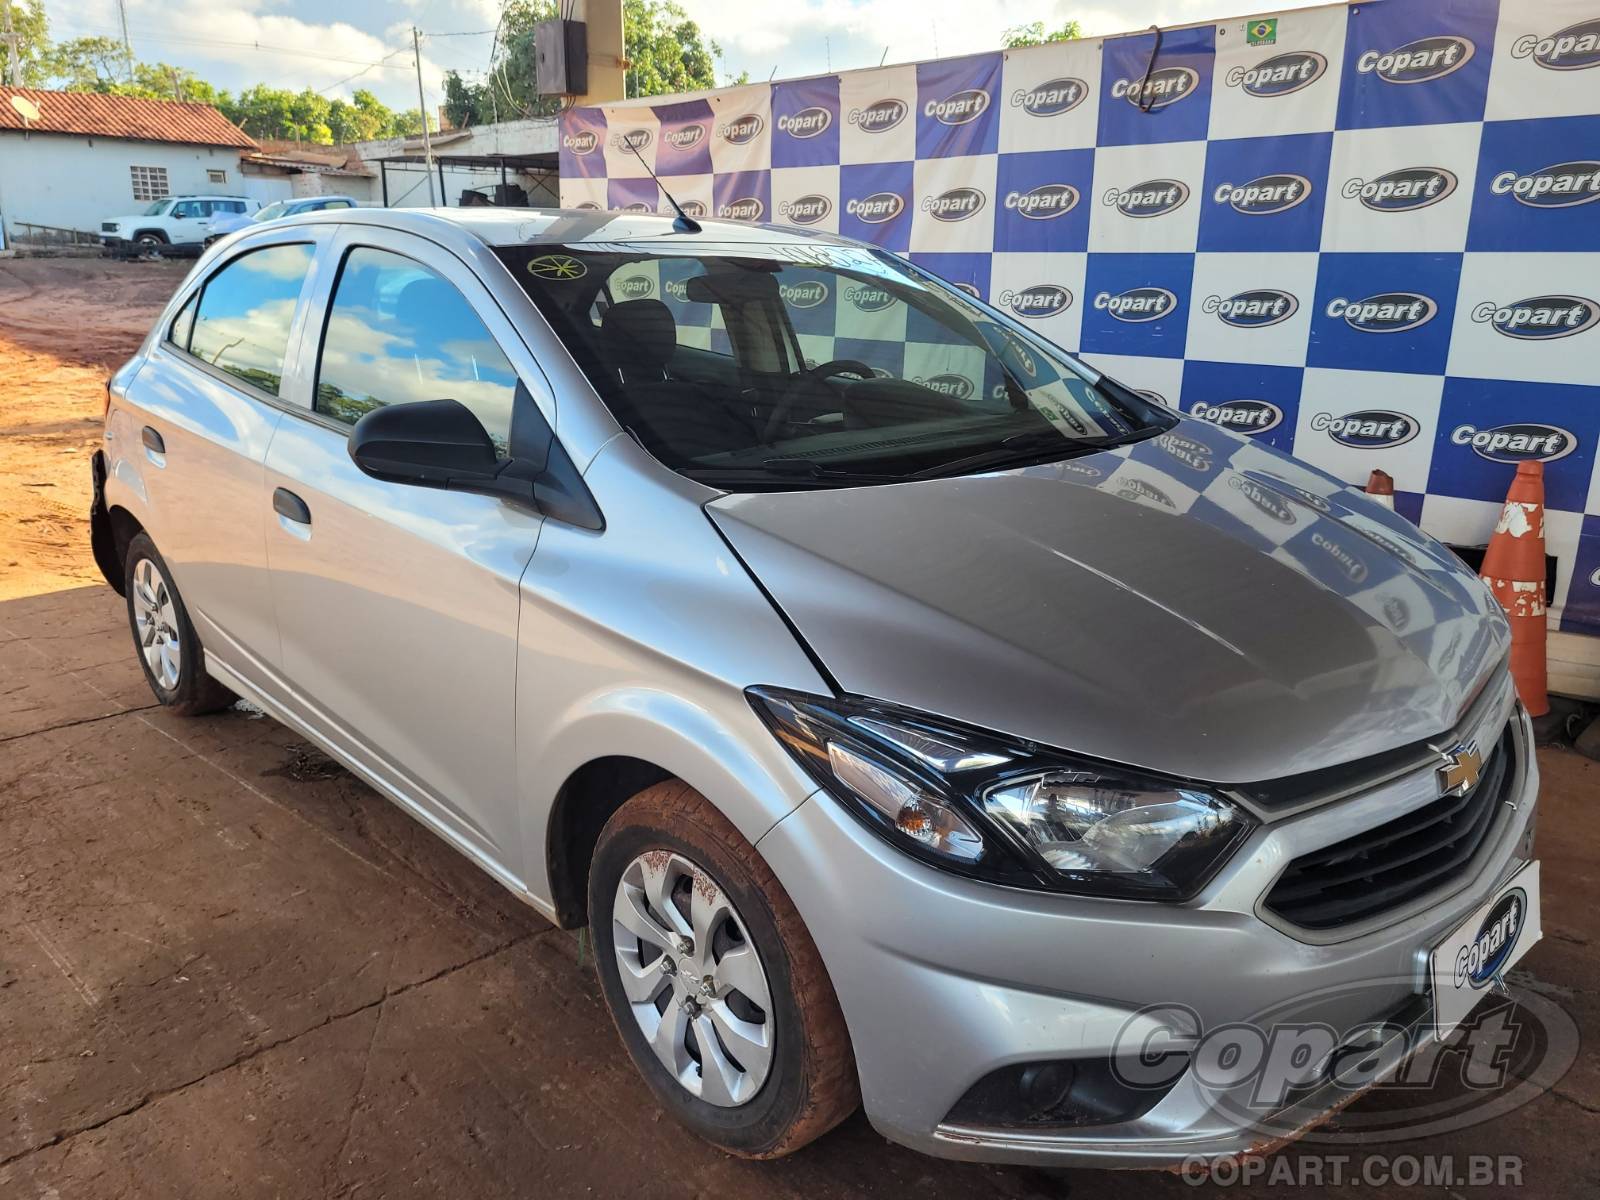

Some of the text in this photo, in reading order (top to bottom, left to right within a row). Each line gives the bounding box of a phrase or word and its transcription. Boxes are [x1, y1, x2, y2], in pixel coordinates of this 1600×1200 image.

[1357, 43, 1459, 75] Copart
[1511, 33, 1600, 62] Copa
[1225, 59, 1314, 88] Copart
[925, 95, 983, 118] Copart
[1011, 85, 1078, 107] Copart
[777, 114, 825, 131] Copart
[848, 105, 900, 126] Copart
[664, 128, 702, 146] Copart
[716, 120, 758, 141] Copart
[563, 135, 594, 150] Copart
[1214, 178, 1298, 206] Copart
[1342, 175, 1441, 202] Copart
[1491, 171, 1600, 199] Copart
[778, 200, 825, 217] Copart
[846, 198, 896, 216] Copart
[921, 194, 976, 215] Copart
[1004, 191, 1069, 213] Copart
[1103, 187, 1178, 210] Copart
[718, 203, 757, 218] Copart
[779, 284, 822, 304] Copart
[999, 290, 1063, 310] Copart
[1094, 292, 1167, 312] Copart
[1202, 295, 1285, 318] Copart
[1326, 298, 1422, 323] Copart
[1471, 302, 1585, 329] Copart
[1190, 402, 1269, 426] Copart
[1310, 412, 1405, 440] Copart
[1451, 425, 1562, 455] Copart
[1454, 897, 1518, 989] Copart
